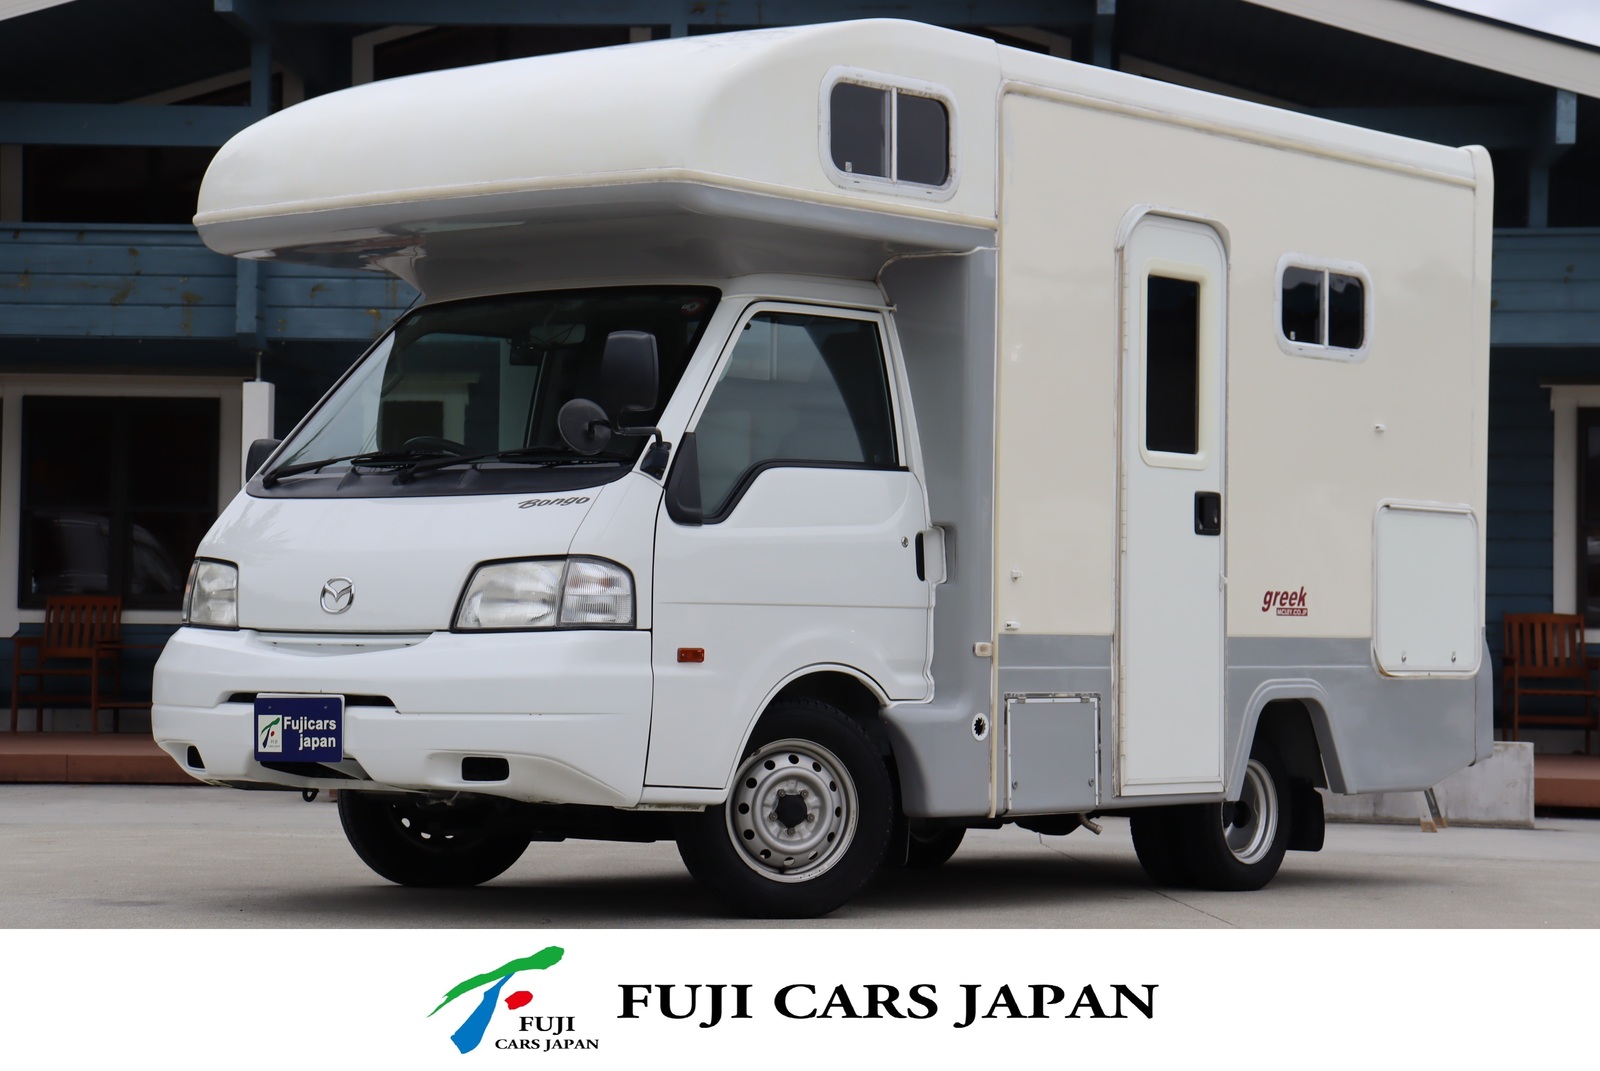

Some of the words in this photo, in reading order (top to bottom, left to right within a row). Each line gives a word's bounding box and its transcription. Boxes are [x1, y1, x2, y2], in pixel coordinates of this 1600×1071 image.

[518, 496, 591, 509] Bongo
[1261, 586, 1307, 612] greek
[283, 716, 337, 734] Fujicars
[298, 733, 336, 751] japan
